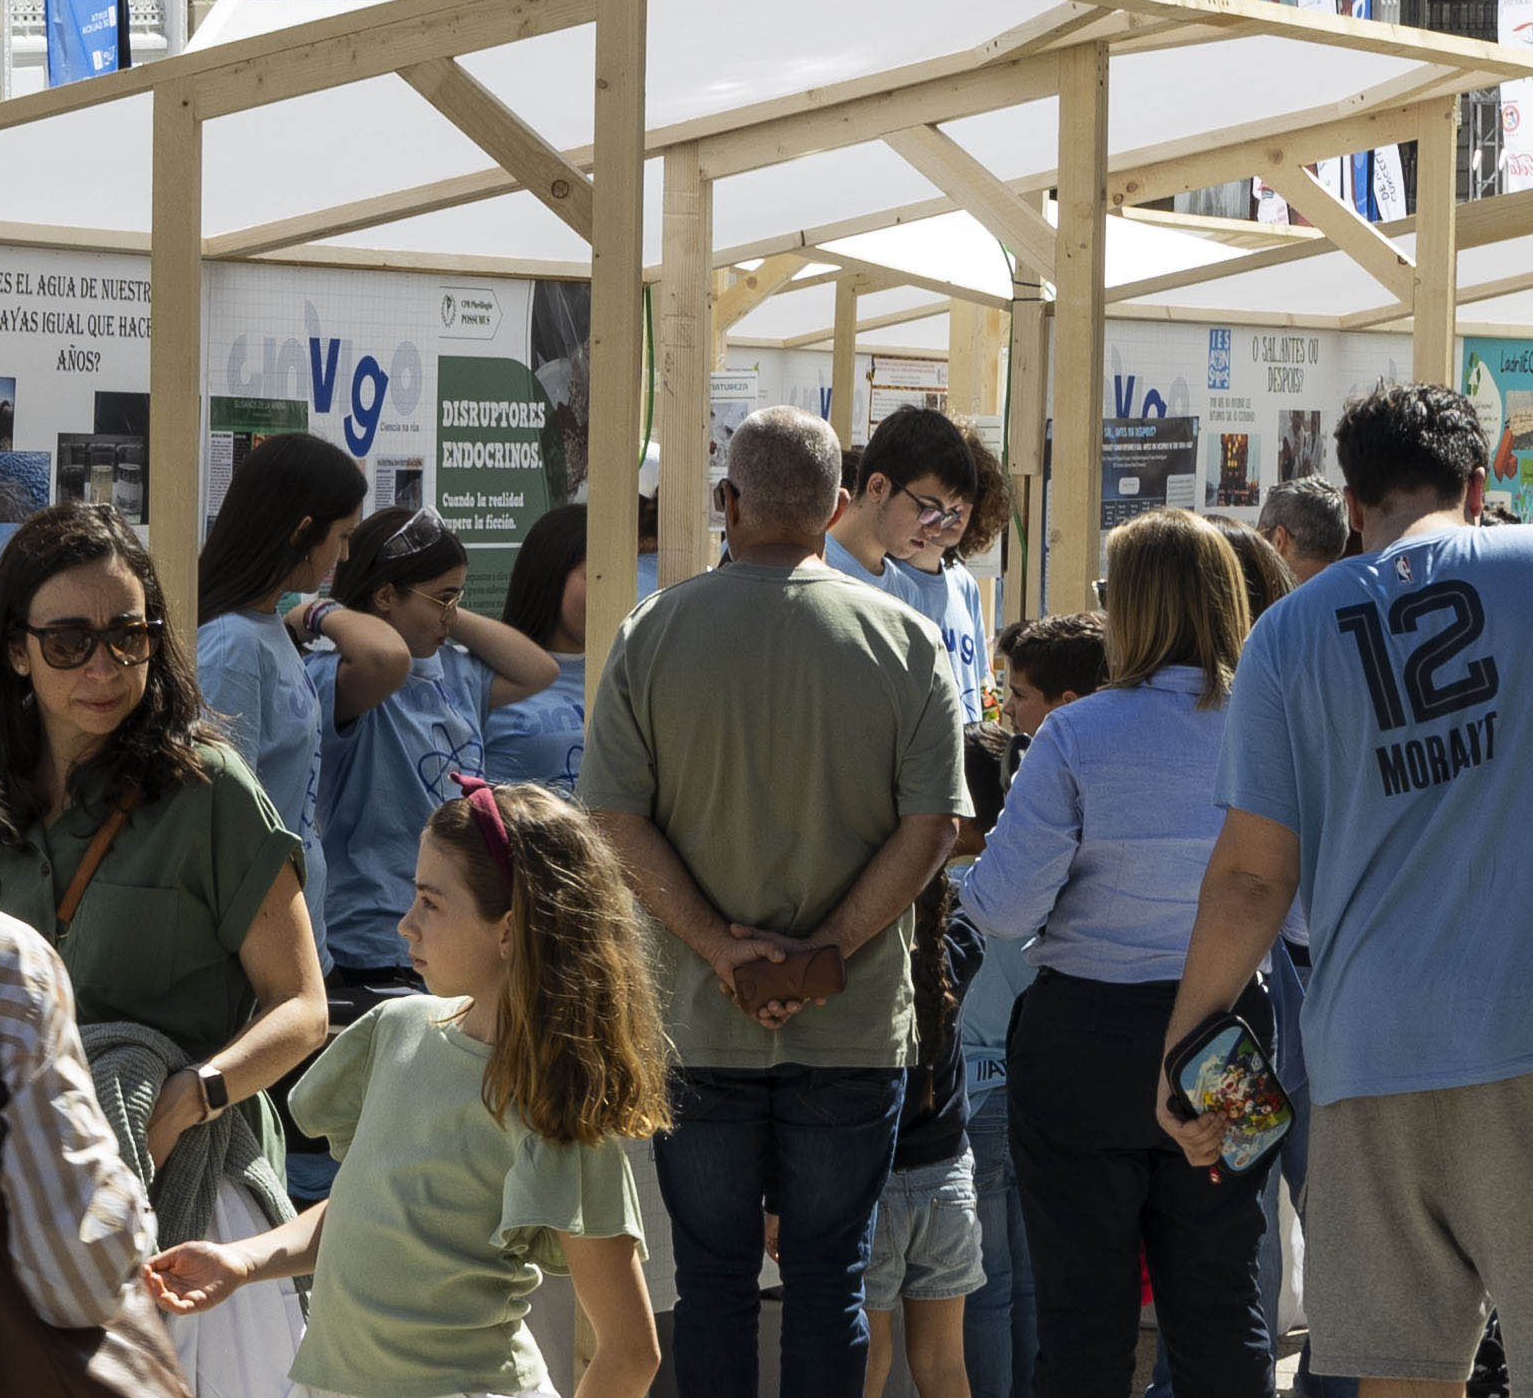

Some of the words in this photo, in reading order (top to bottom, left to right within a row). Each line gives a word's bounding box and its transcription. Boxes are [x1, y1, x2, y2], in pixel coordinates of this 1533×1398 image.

[16, 273, 33, 296] EL
[37, 274, 76, 299] AGUA
[81, 277, 97, 298] DE
[101, 277, 151, 301] NUESTR
[42, 313, 84, 335] IGUAL
[87, 314, 114, 339] QUE
[56, 344, 100, 372] AÑOS?
[380, 421, 400, 433] Ciencia
[442, 400, 546, 429] DISRUPTORES
[442, 441, 543, 469] ENDOCRINOS.
[442, 492, 475, 507] Cuando
[477, 493, 487, 507] la
[489, 492, 524, 507] realidad
[475, 514, 484, 529] la
[486, 514, 517, 530] ficción.
[1336, 579, 1499, 731] 12
